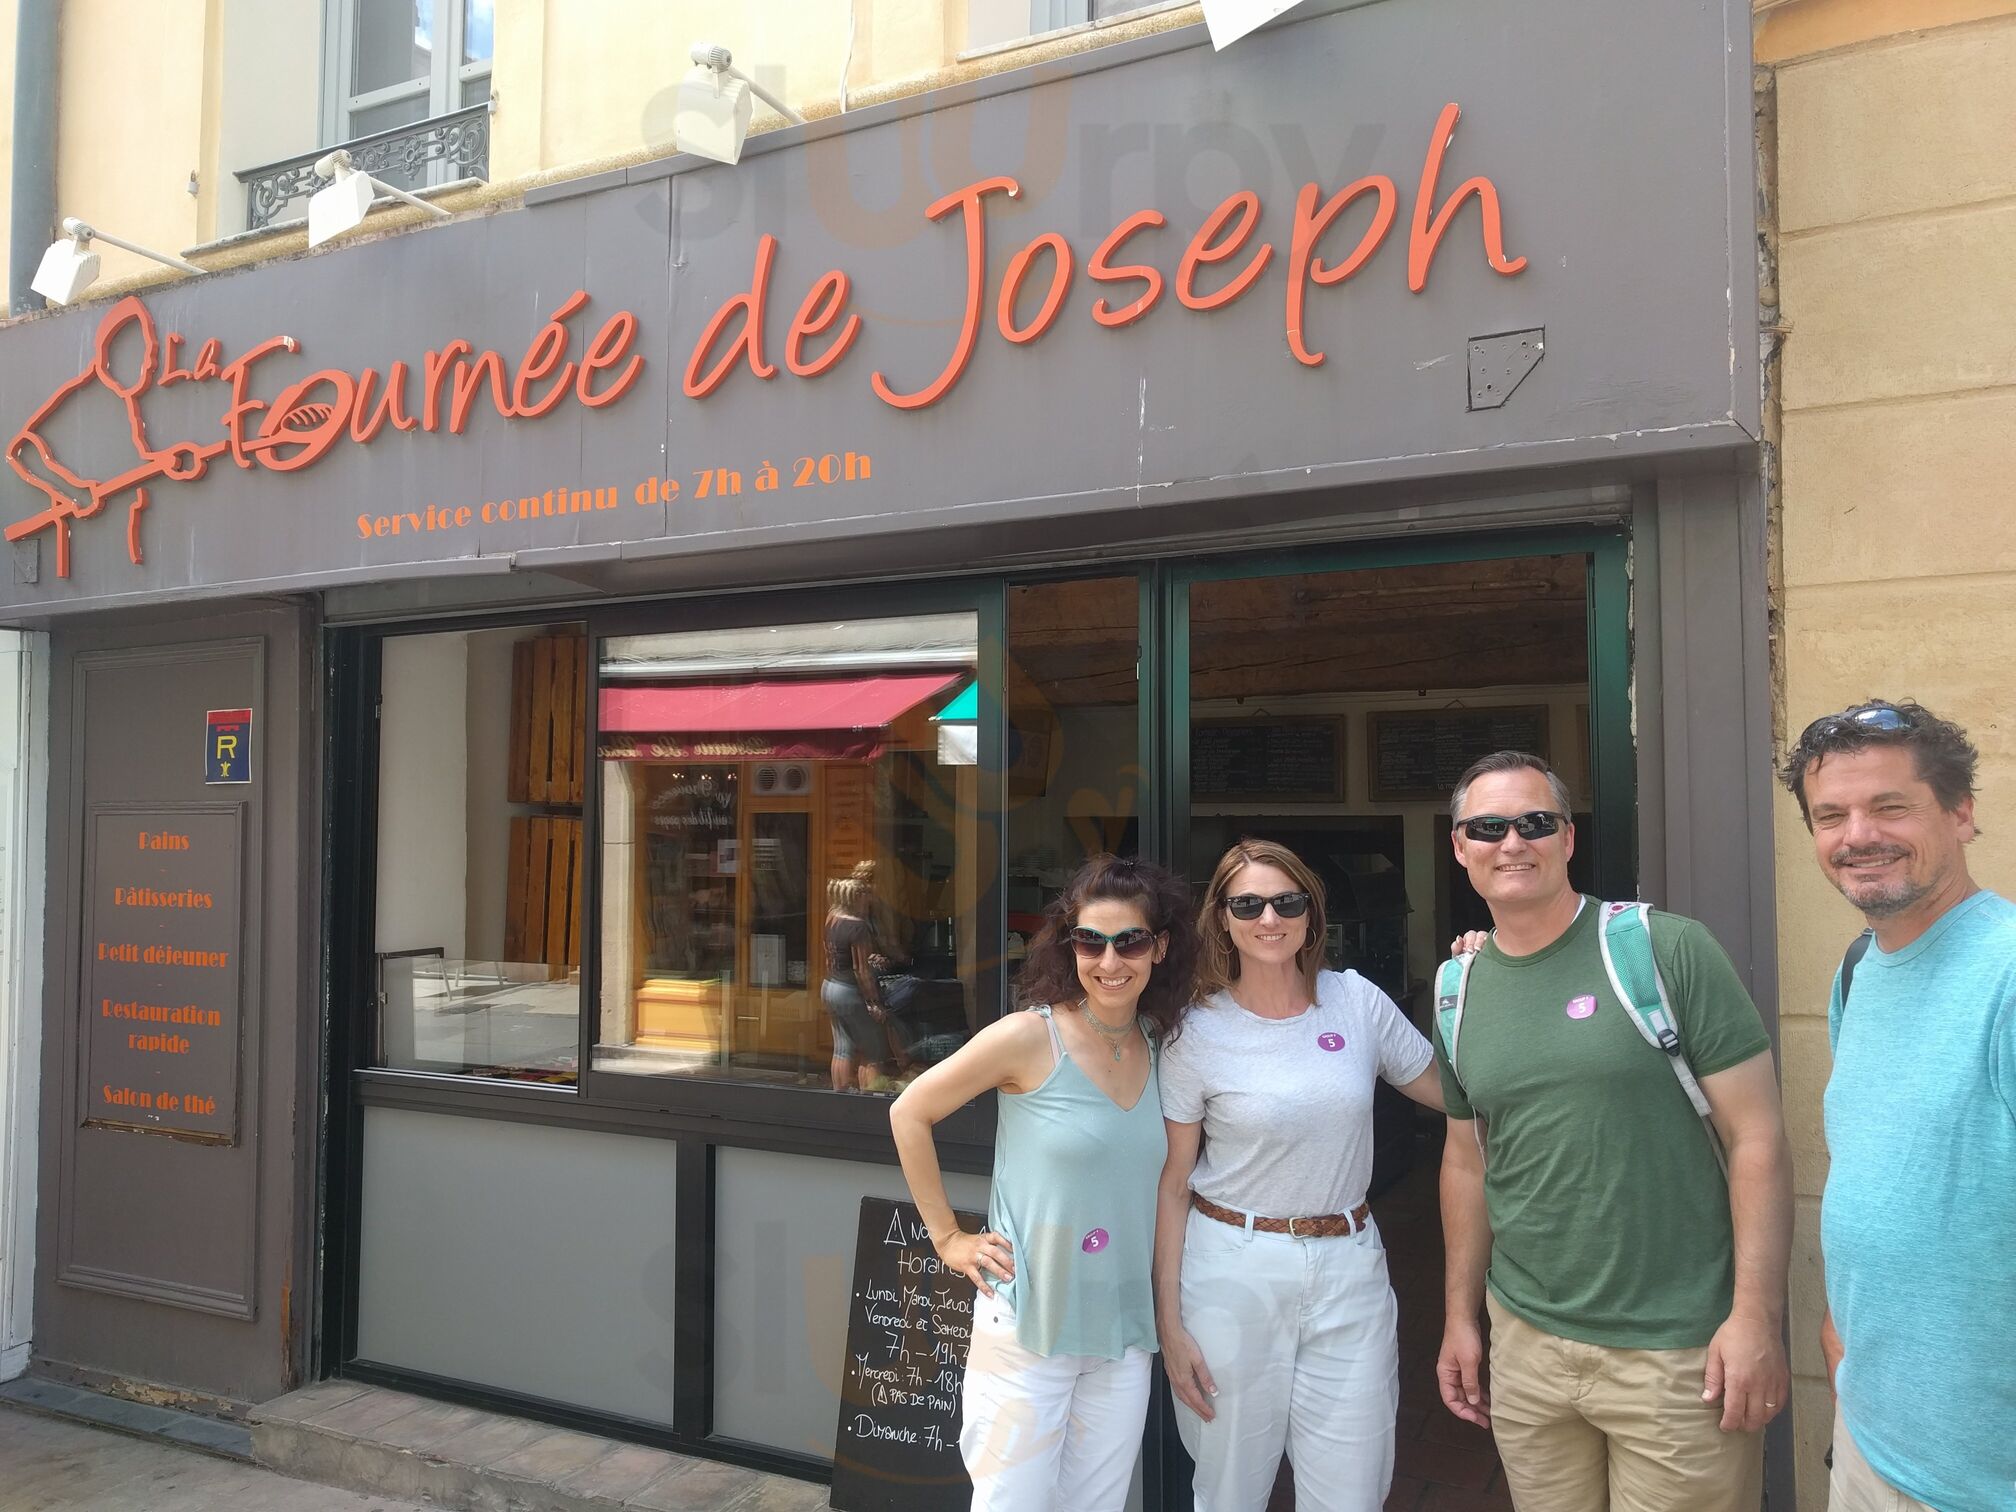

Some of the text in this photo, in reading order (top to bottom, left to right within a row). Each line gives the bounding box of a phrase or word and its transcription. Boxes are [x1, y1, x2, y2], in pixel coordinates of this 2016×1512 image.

[157, 102, 1528, 472] La Fournée de Joseph
[357, 451, 873, 540] Service continu de 7h à 20h
[217, 735, 238, 760] R
[138, 831, 190, 850] Pains
[114, 886, 214, 910] Pâtisseries
[98, 942, 229, 969] Petit déjeuner
[102, 998, 221, 1027] Restauration
[1579, 1002, 1587, 1014] 5
[128, 1033, 191, 1055] rapide
[1327, 1038, 1336, 1048] 5
[103, 1084, 216, 1116] Salon de thé
[1090, 1235, 1099, 1248] 5
[884, 1330, 911, 1365] 7h
[929, 1340, 970, 1370] 19h3
[906, 1366, 923, 1387] 7h
[889, 1387, 908, 1405] PAS
[923, 1425, 943, 1452] 7h
